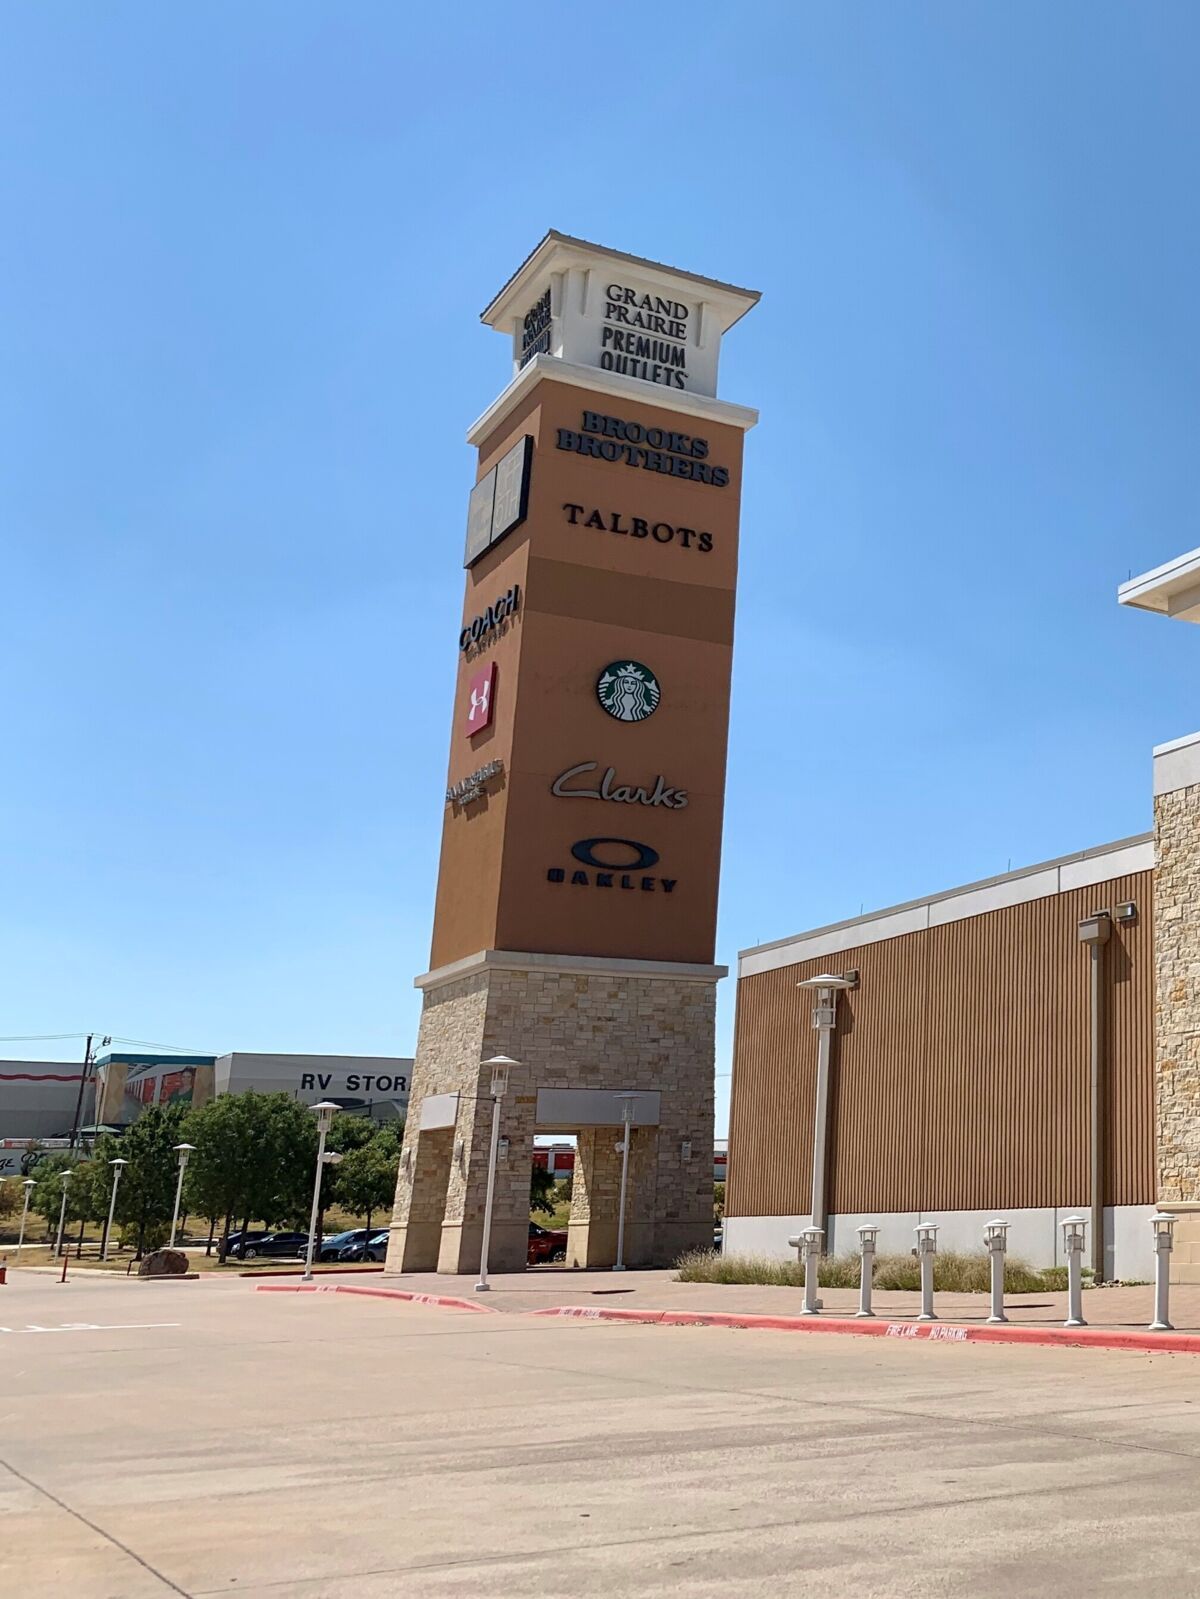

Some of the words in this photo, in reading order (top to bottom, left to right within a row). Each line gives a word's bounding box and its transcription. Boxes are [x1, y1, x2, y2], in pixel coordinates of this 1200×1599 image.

[605, 302, 687, 340] PRAIRIE
[606, 284, 689, 320] GRAND
[602, 327, 686, 369] PREMIUM
[600, 351, 687, 390] OUTLETS
[583, 410, 709, 459] BROOKS
[556, 428, 730, 488] BROTHERS
[562, 503, 714, 552] TALBOTS
[460, 584, 520, 651] COACH
[551, 761, 689, 810] Clarks
[547, 867, 678, 894] OAKLEY
[301, 1073, 332, 1091] RV
[346, 1074, 411, 1092] STOR
[886, 1324, 903, 1337] FIRE
[901, 1325, 920, 1338] LANE
